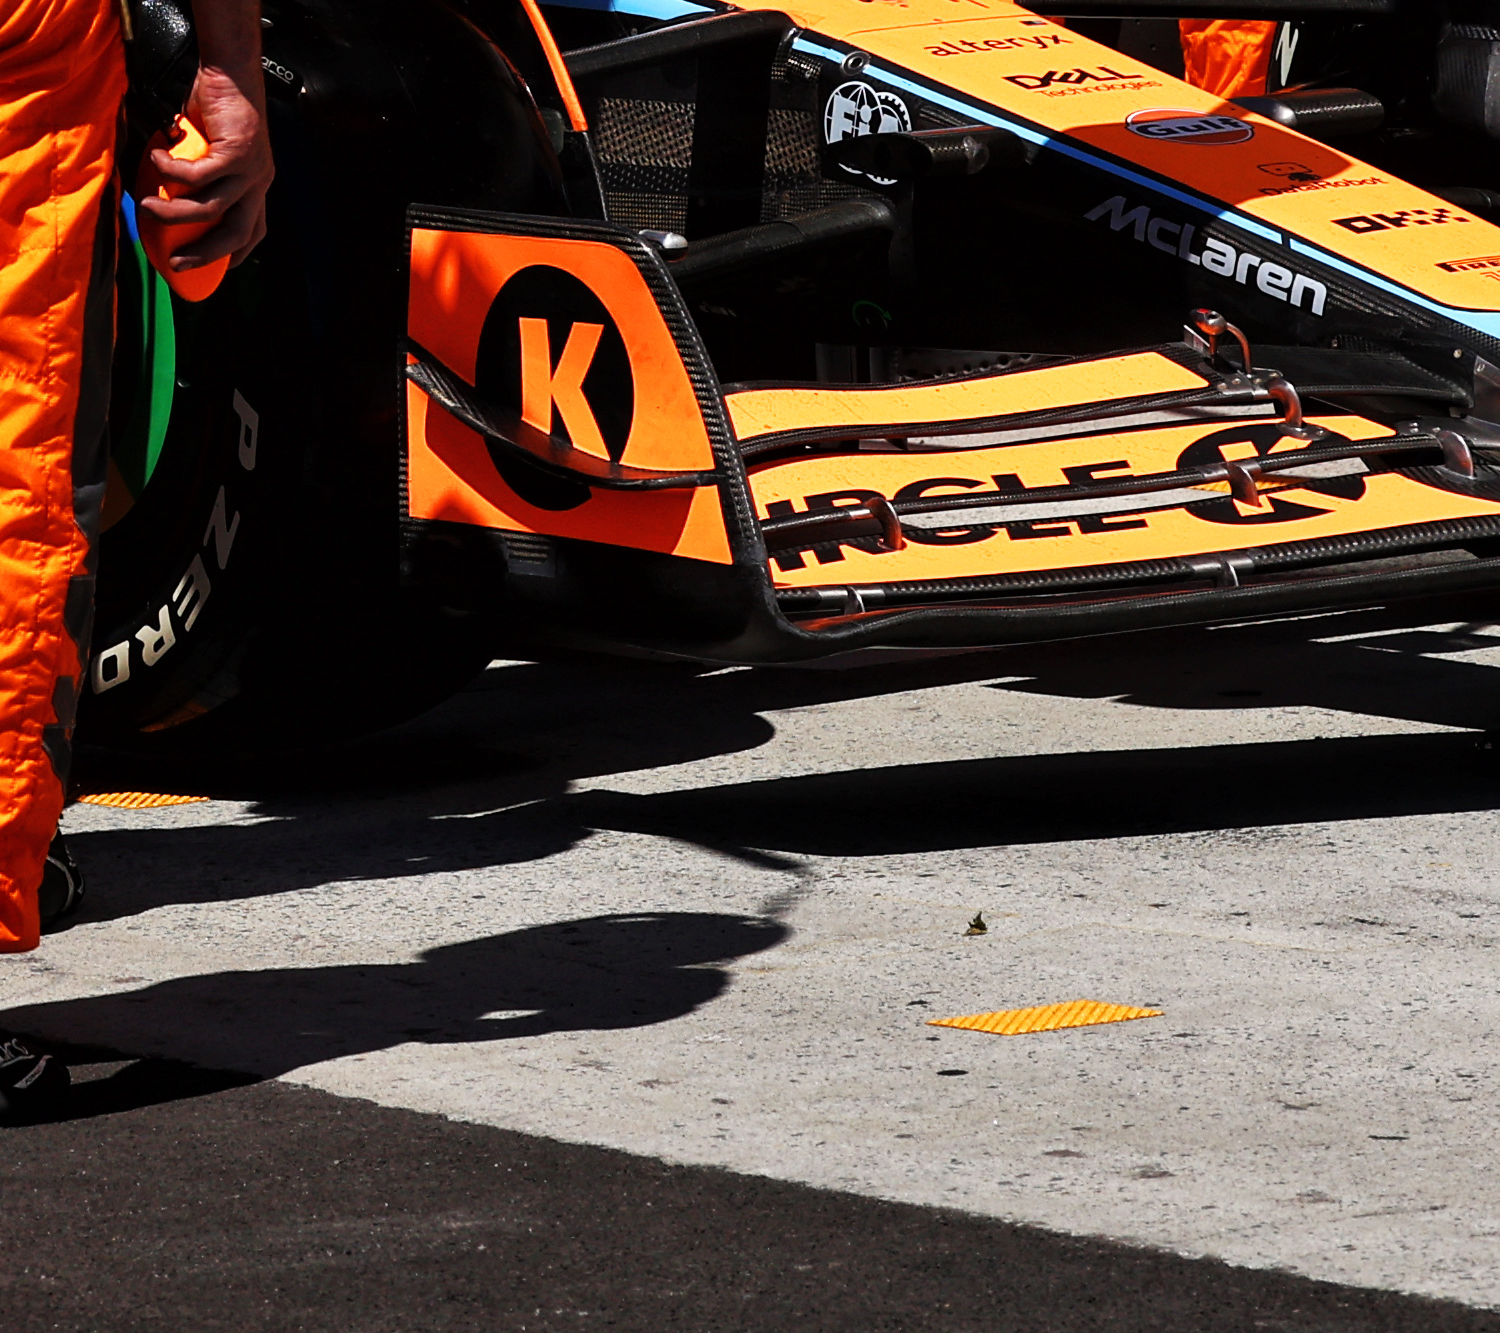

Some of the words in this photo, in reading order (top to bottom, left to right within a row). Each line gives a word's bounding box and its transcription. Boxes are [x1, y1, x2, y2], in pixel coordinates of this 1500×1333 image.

[923, 33, 1075, 58] alteryx
[1002, 65, 1147, 90] DELL
[1034, 79, 1164, 99] Technologies
[1134, 116, 1243, 137] Gulf
[1258, 176, 1390, 198] DataRobot
[1082, 194, 1328, 317] McLaren
[519, 316, 611, 462] K
[230, 388, 260, 472] P
[90, 485, 241, 694] ZERO
